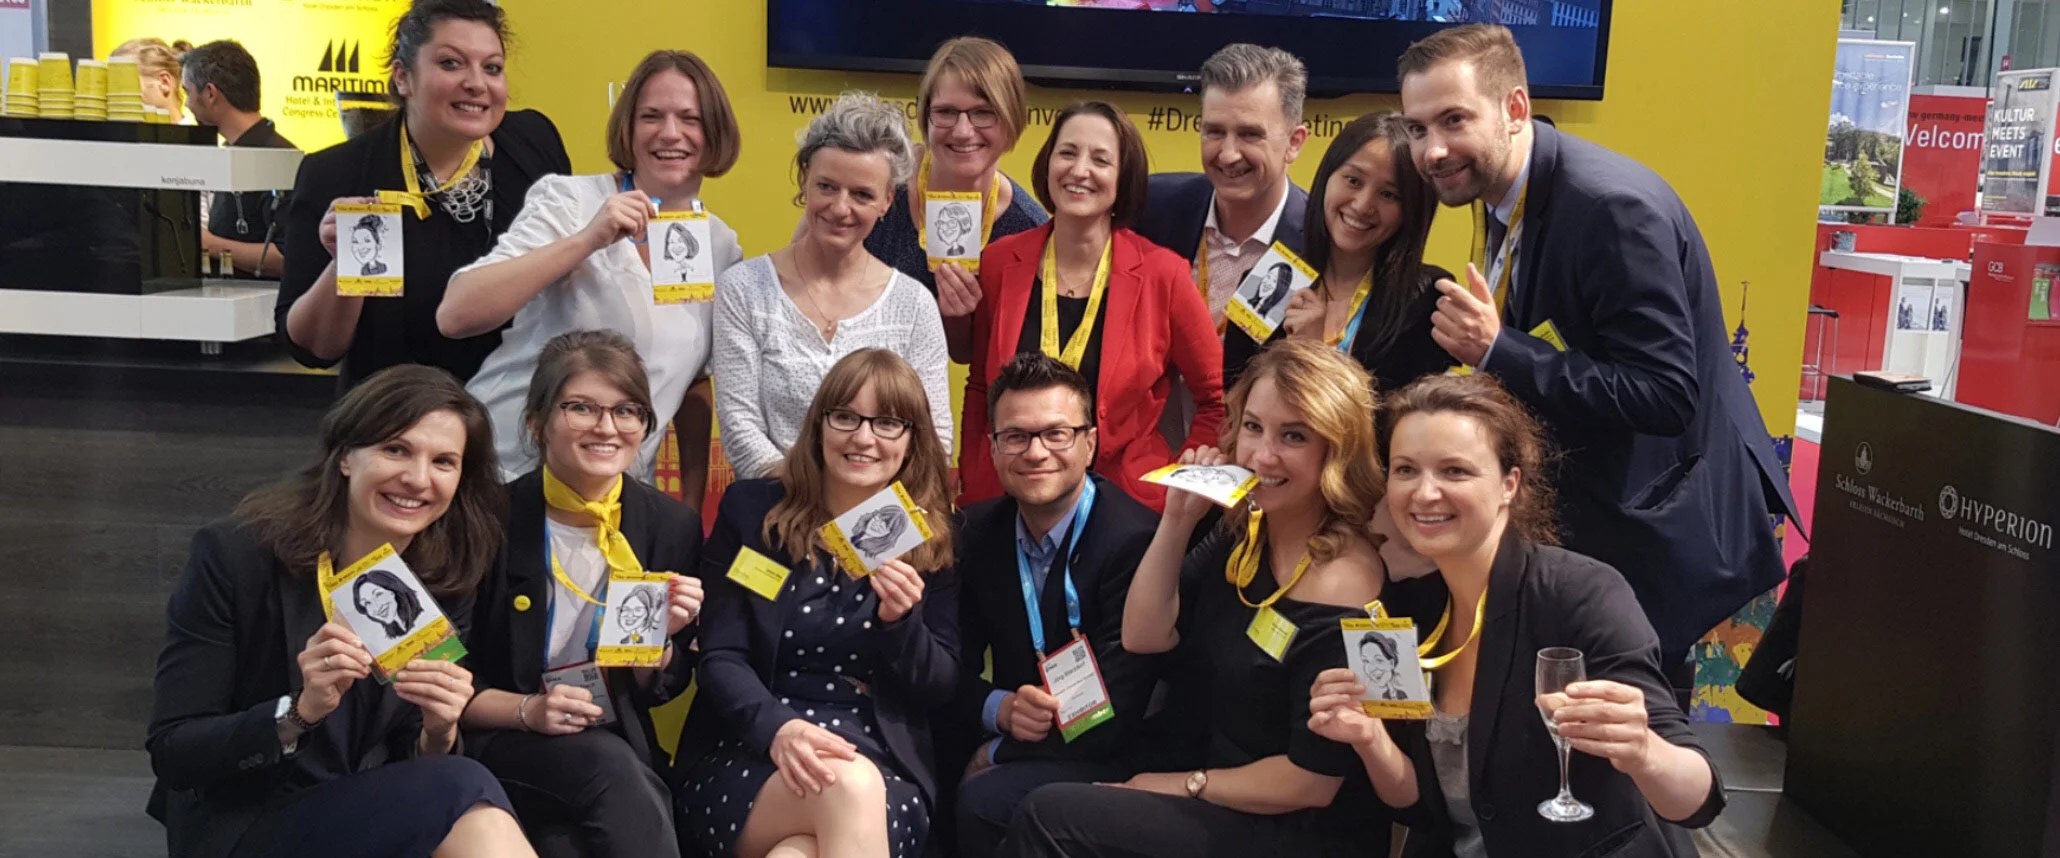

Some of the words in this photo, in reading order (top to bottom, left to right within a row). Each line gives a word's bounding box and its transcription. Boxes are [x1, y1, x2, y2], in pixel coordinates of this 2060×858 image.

[292, 76, 385, 94] MARITIM
[285, 97, 311, 106] Hotel
[313, 96, 320, 105] &
[282, 107, 323, 118] Congress
[1993, 107, 2035, 123] KULTUR
[1991, 126, 2026, 141] MEETS
[1989, 144, 2025, 159] EVENT
[1987, 261, 2004, 273] GCB
[1835, 473, 1867, 499] Schloss
[1868, 484, 1924, 522] Wackerbarth
